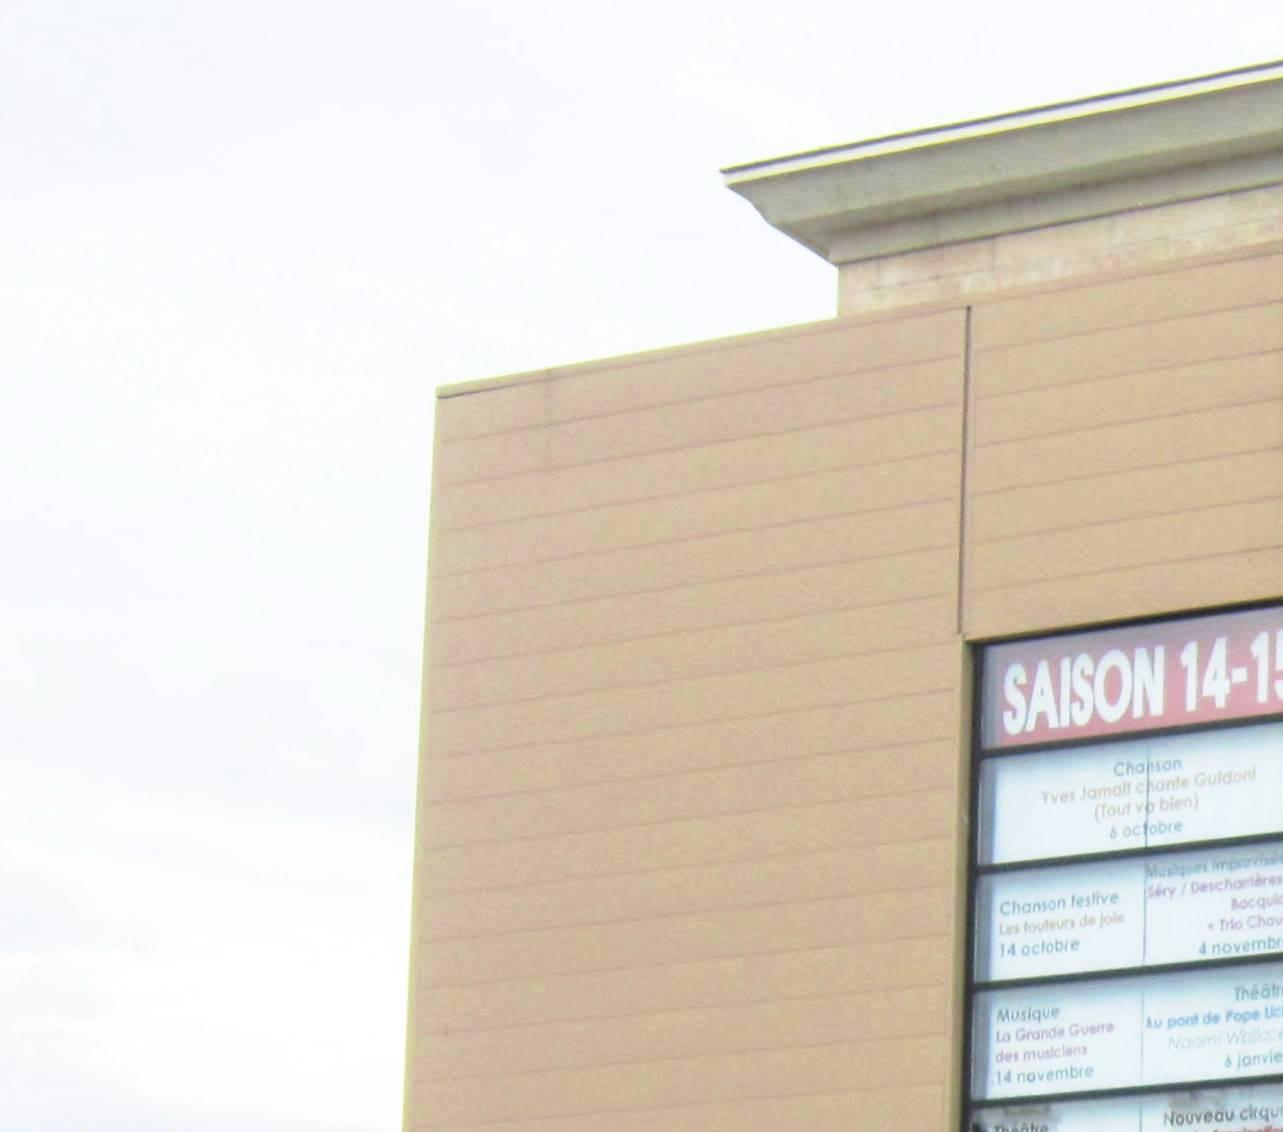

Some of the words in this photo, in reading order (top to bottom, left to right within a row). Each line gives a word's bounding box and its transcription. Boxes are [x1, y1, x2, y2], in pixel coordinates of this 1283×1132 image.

[1002, 644, 1165, 735] SAISON
[1113, 758, 1182, 777] Chanson
[1041, 790, 1075, 805] Yves
[1109, 827, 1118, 840] 6
[1122, 820, 1184, 838] octobre
[1000, 897, 1066, 916] Chanson
[1071, 891, 1120, 908] festive
[999, 922, 1020, 936] Les
[1079, 914, 1096, 928] de
[1000, 942, 1016, 958] 14
[1021, 938, 1080, 957] octobre
[1199, 941, 1207, 955] 4
[997, 1006, 1060, 1024] Musique
[1167, 1013, 1199, 1031] pont
[1202, 1011, 1220, 1025] de
[996, 1031, 1010, 1043] La
[1015, 1025, 1064, 1042] Grande
[1069, 1022, 1114, 1036] Guerre
[995, 1050, 1018, 1063] des
[1224, 1054, 1232, 1068] 6
[996, 1071, 1012, 1085] 14
[1016, 1065, 1094, 1084] novembre
[1163, 1108, 1234, 1127] Nouveau
